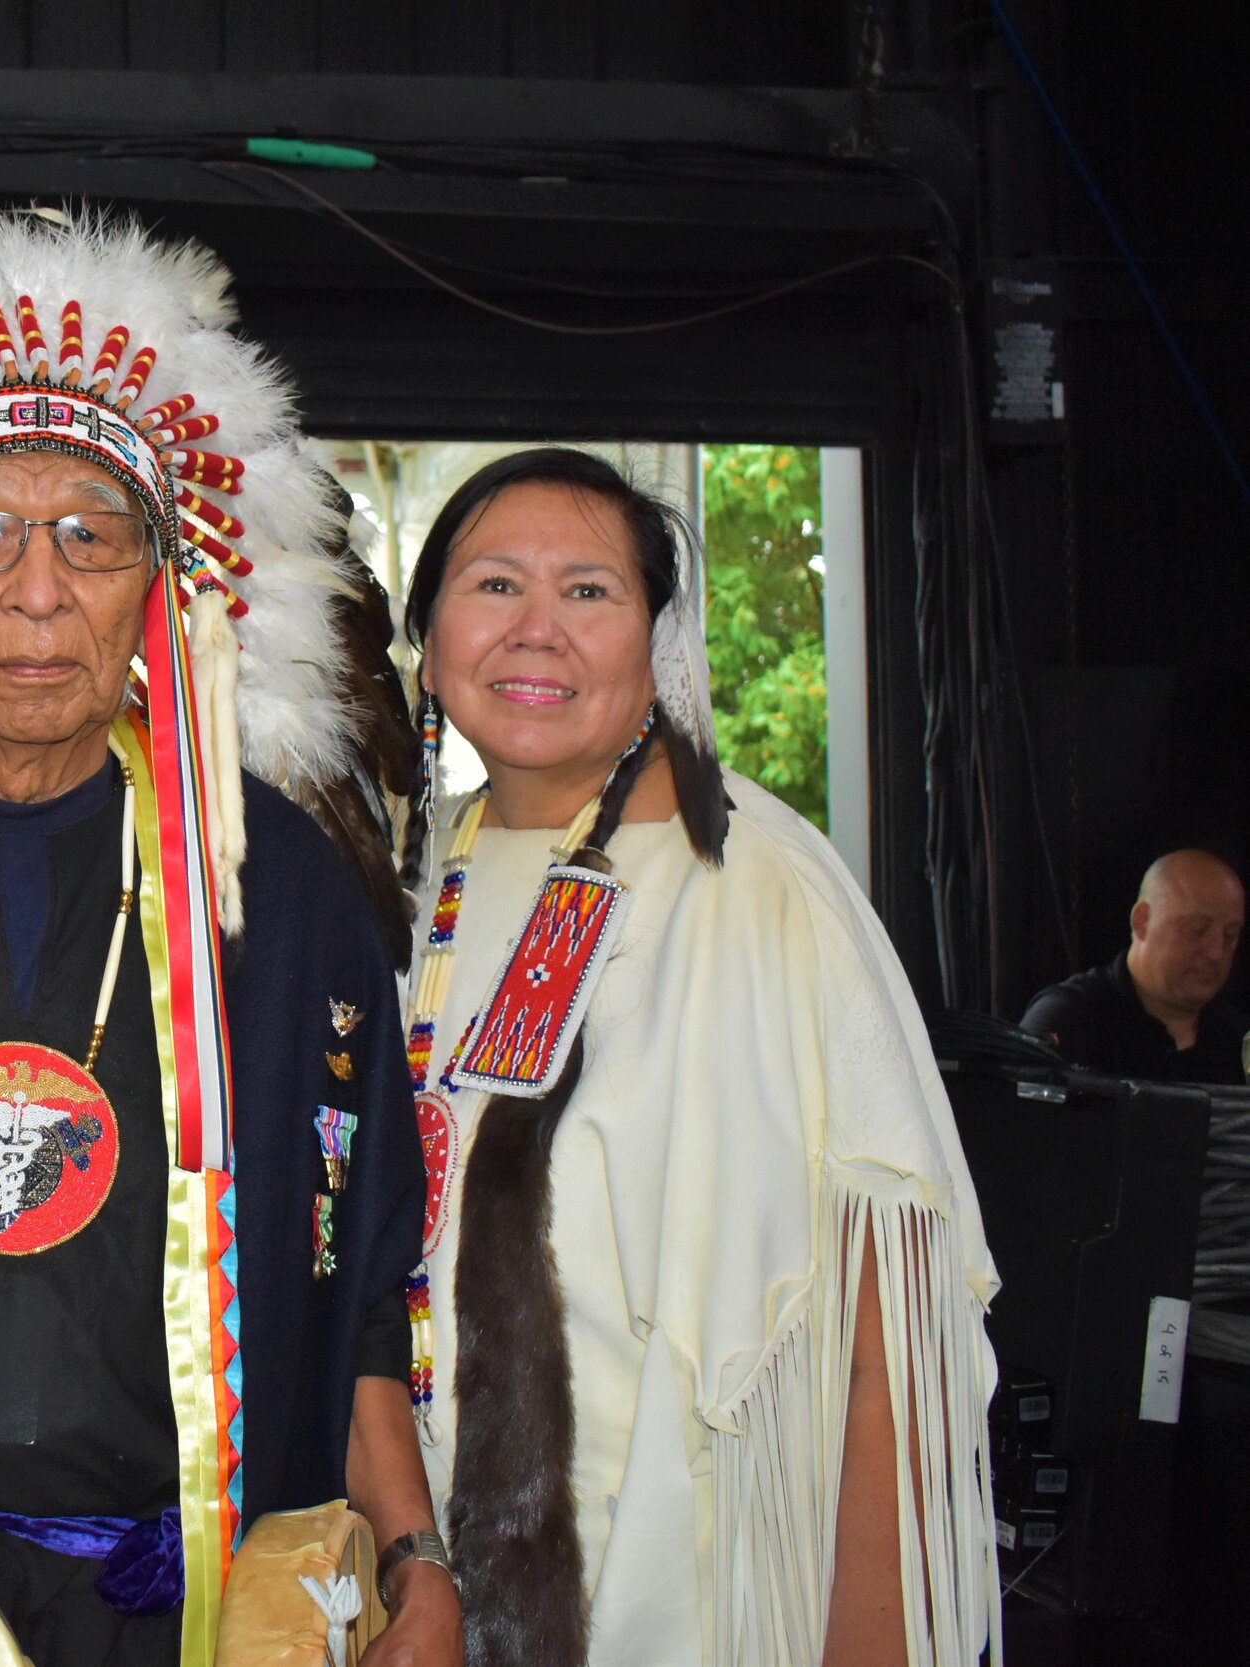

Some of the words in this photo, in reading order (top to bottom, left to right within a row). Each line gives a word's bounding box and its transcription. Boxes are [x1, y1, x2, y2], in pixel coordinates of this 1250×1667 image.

[1161, 1323, 1177, 1334] 4
[1159, 1344, 1172, 1358] of
[1157, 1369, 1170, 1384] 15
